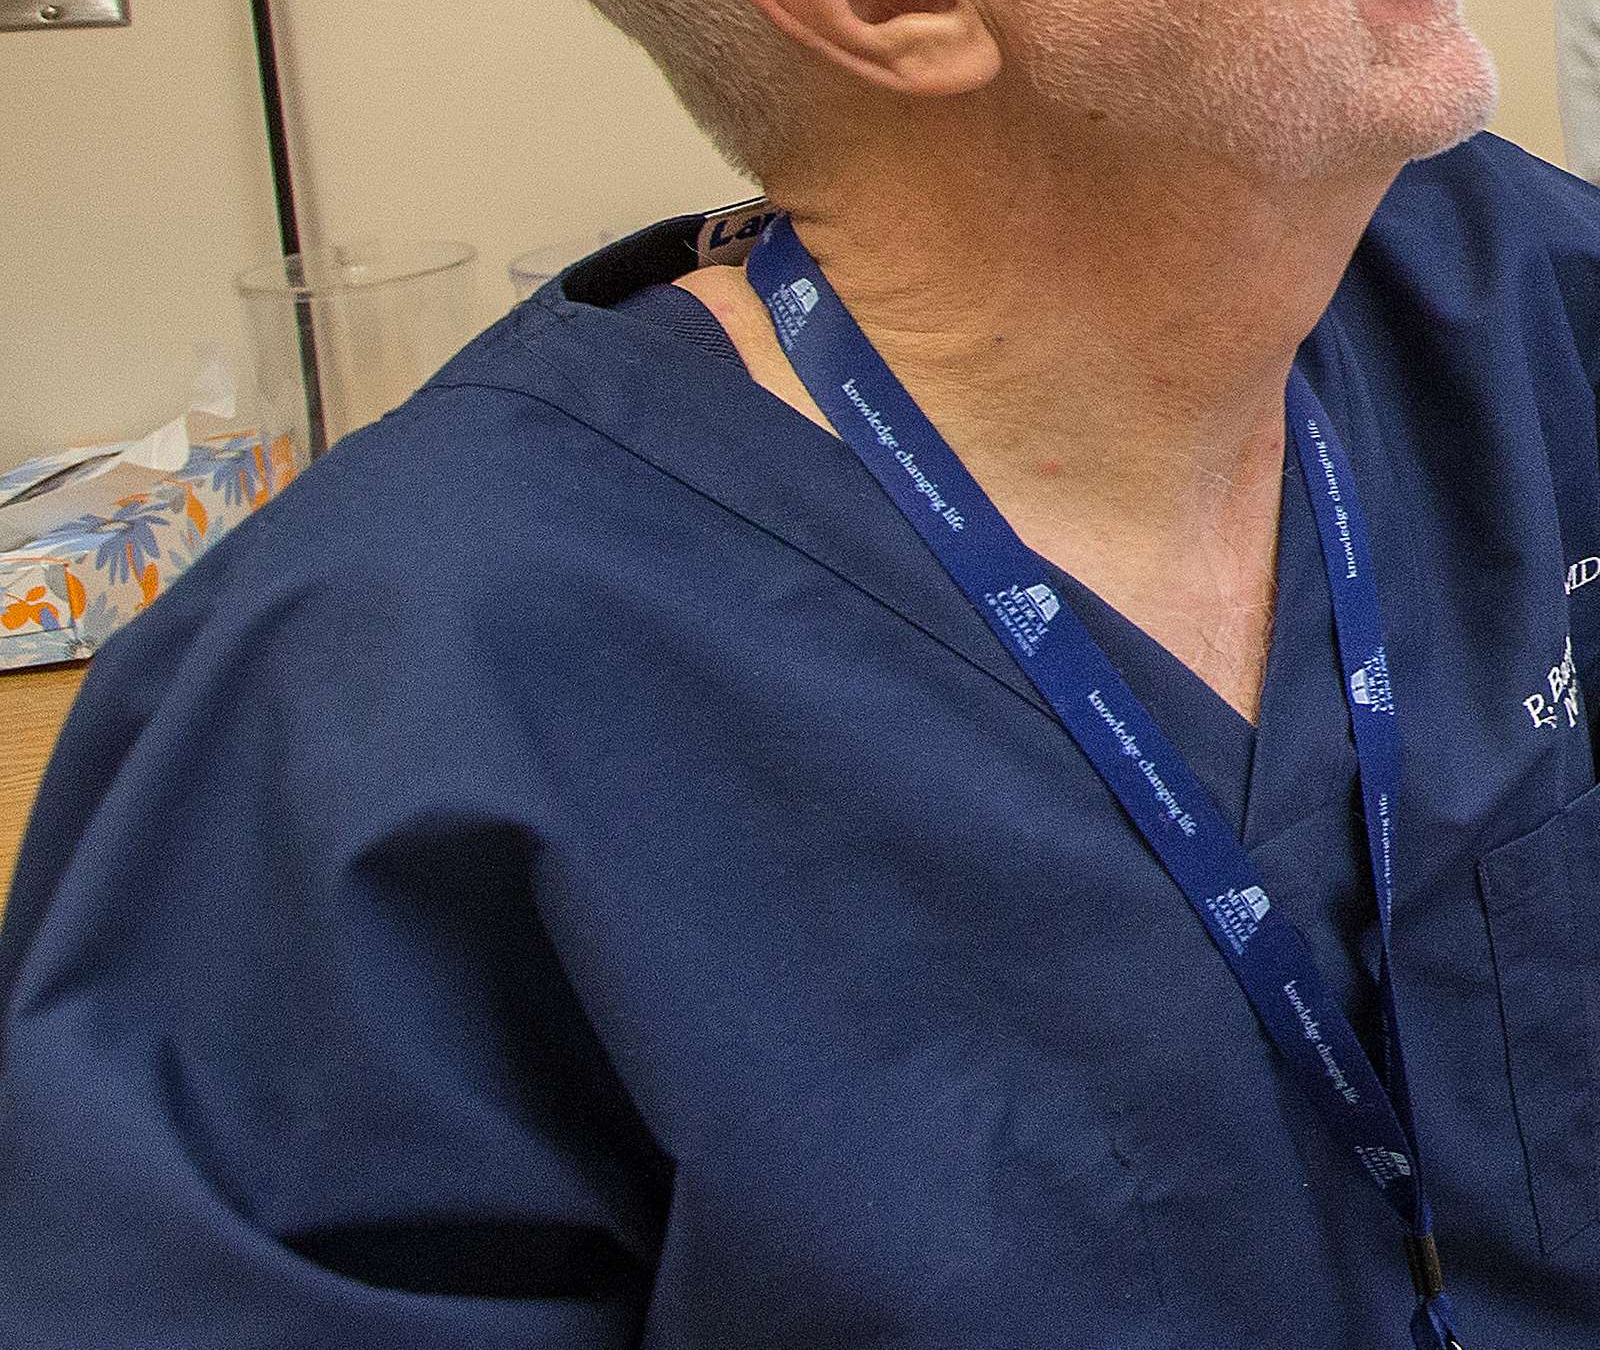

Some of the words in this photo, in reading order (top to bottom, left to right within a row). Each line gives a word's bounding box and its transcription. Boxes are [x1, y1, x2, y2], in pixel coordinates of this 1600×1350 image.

[841, 377, 899, 450] knowledge
[894, 448, 947, 512] changing
[942, 504, 966, 534] life
[1306, 416, 1328, 444] life
[1315, 439, 1343, 501] changing
[1331, 496, 1358, 580] knowledge
[1085, 688, 1143, 761] knowledge
[1136, 756, 1184, 822] changing
[1175, 807, 1198, 839] life
[1282, 979, 1323, 1044] knowledge
[1316, 1041, 1346, 1089] changing
[1340, 1076, 1359, 1106] life
